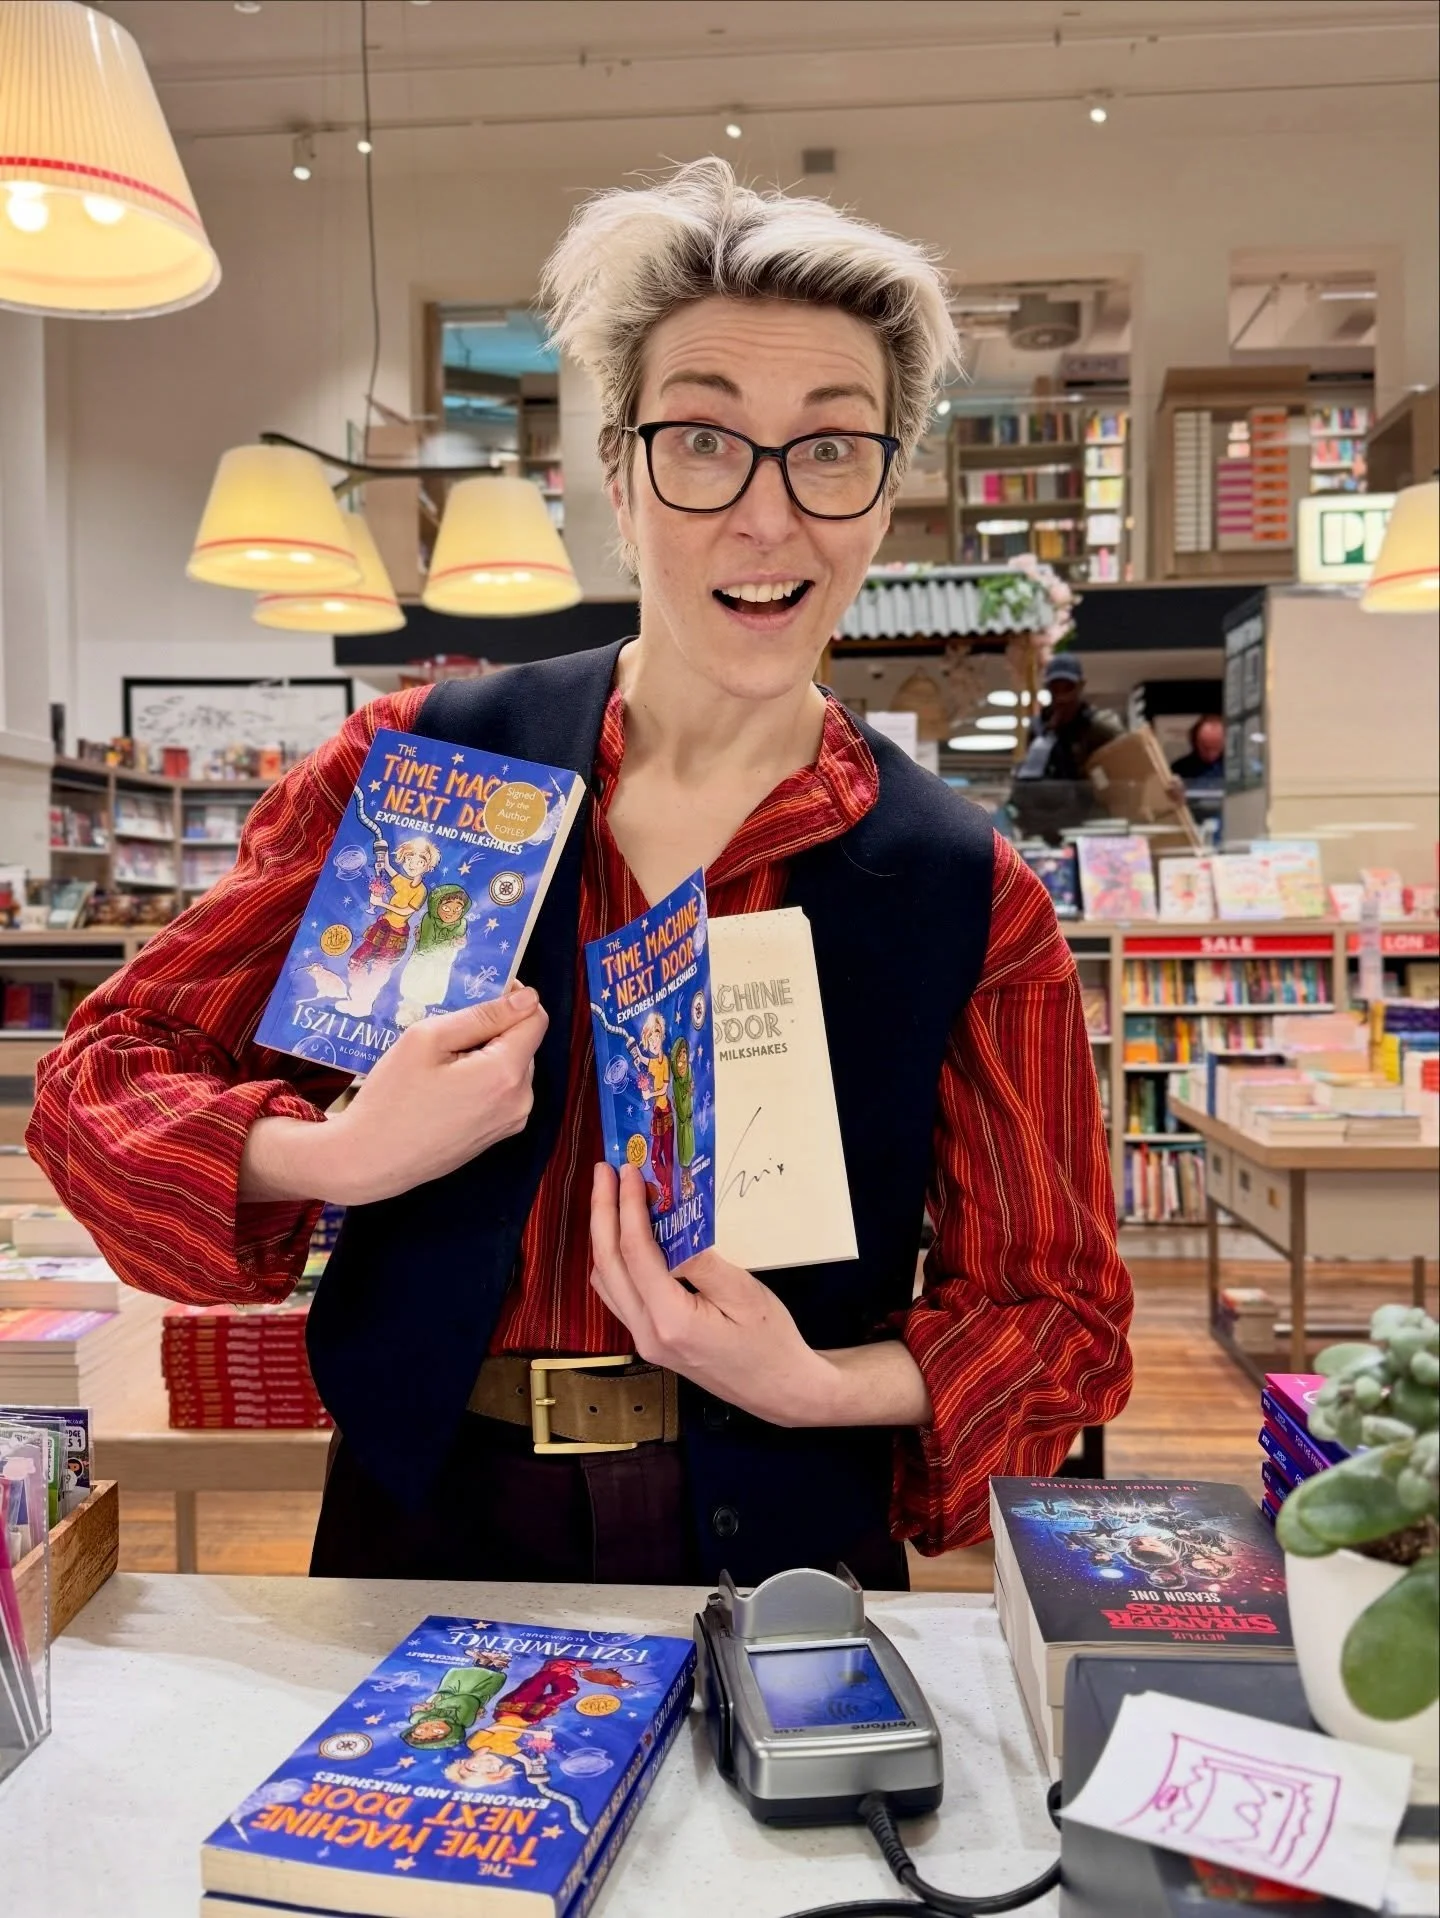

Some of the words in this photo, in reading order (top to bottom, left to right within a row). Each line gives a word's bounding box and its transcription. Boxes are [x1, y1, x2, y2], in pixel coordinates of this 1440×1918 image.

[398, 743, 418, 758] THE
[381, 753, 443, 791] TIME
[506, 787, 537, 800] Signed
[382, 784, 451, 821] NEXT
[457, 804, 488, 833] DO
[505, 799, 514, 808] by
[517, 802, 530, 810] the
[497, 808, 531, 823] Author
[375, 810, 435, 834] EXPLORERS
[435, 824, 458, 840] AND
[460, 831, 524, 856] MILKSHAKES
[494, 824, 525, 838] FOYLES
[602, 942, 644, 985] TIME
[644, 896, 699, 962] MACHINE
[606, 938, 622, 954] THE
[1201, 936, 1255, 952] SALE
[615, 965, 655, 1010] NEXT
[660, 936, 695, 984] DOOR
[616, 996, 655, 1024] EXPLORERS
[655, 987, 668, 1004] AND
[667, 962, 698, 996] MILKSHAKES
[292, 1004, 337, 1035] ISZI
[337, 1017, 397, 1051] LAWR
[340, 1045, 382, 1063] BLOOMSB
[720, 1042, 788, 1062] MILKSHAKES
[665, 1192, 704, 1241] LAWRENCE
[1128, 1590, 1160, 1601] ONE
[1165, 1590, 1221, 1603] SEASON
[1125, 1604, 1236, 1618] THINGS
[1101, 1610, 1280, 1634] STRANGER
[442, 1631, 588, 1659] LAWRENCE
[520, 1632, 585, 1642] BLOOMSBURY
[1172, 1631, 1227, 1641] NETFLIX
[590, 1645, 649, 1663] ISZI
[852, 1720, 918, 1730] Verifone
[312, 1771, 411, 1795] MILKSHAKES
[414, 1786, 450, 1799] AND
[301, 1783, 414, 1820] DOOR
[452, 1790, 551, 1810] EXPLORERS
[422, 1802, 538, 1834] NEXT
[250, 1804, 432, 1854] MACHINE
[434, 1830, 539, 1867] TIME
[478, 1862, 514, 1878] THE
